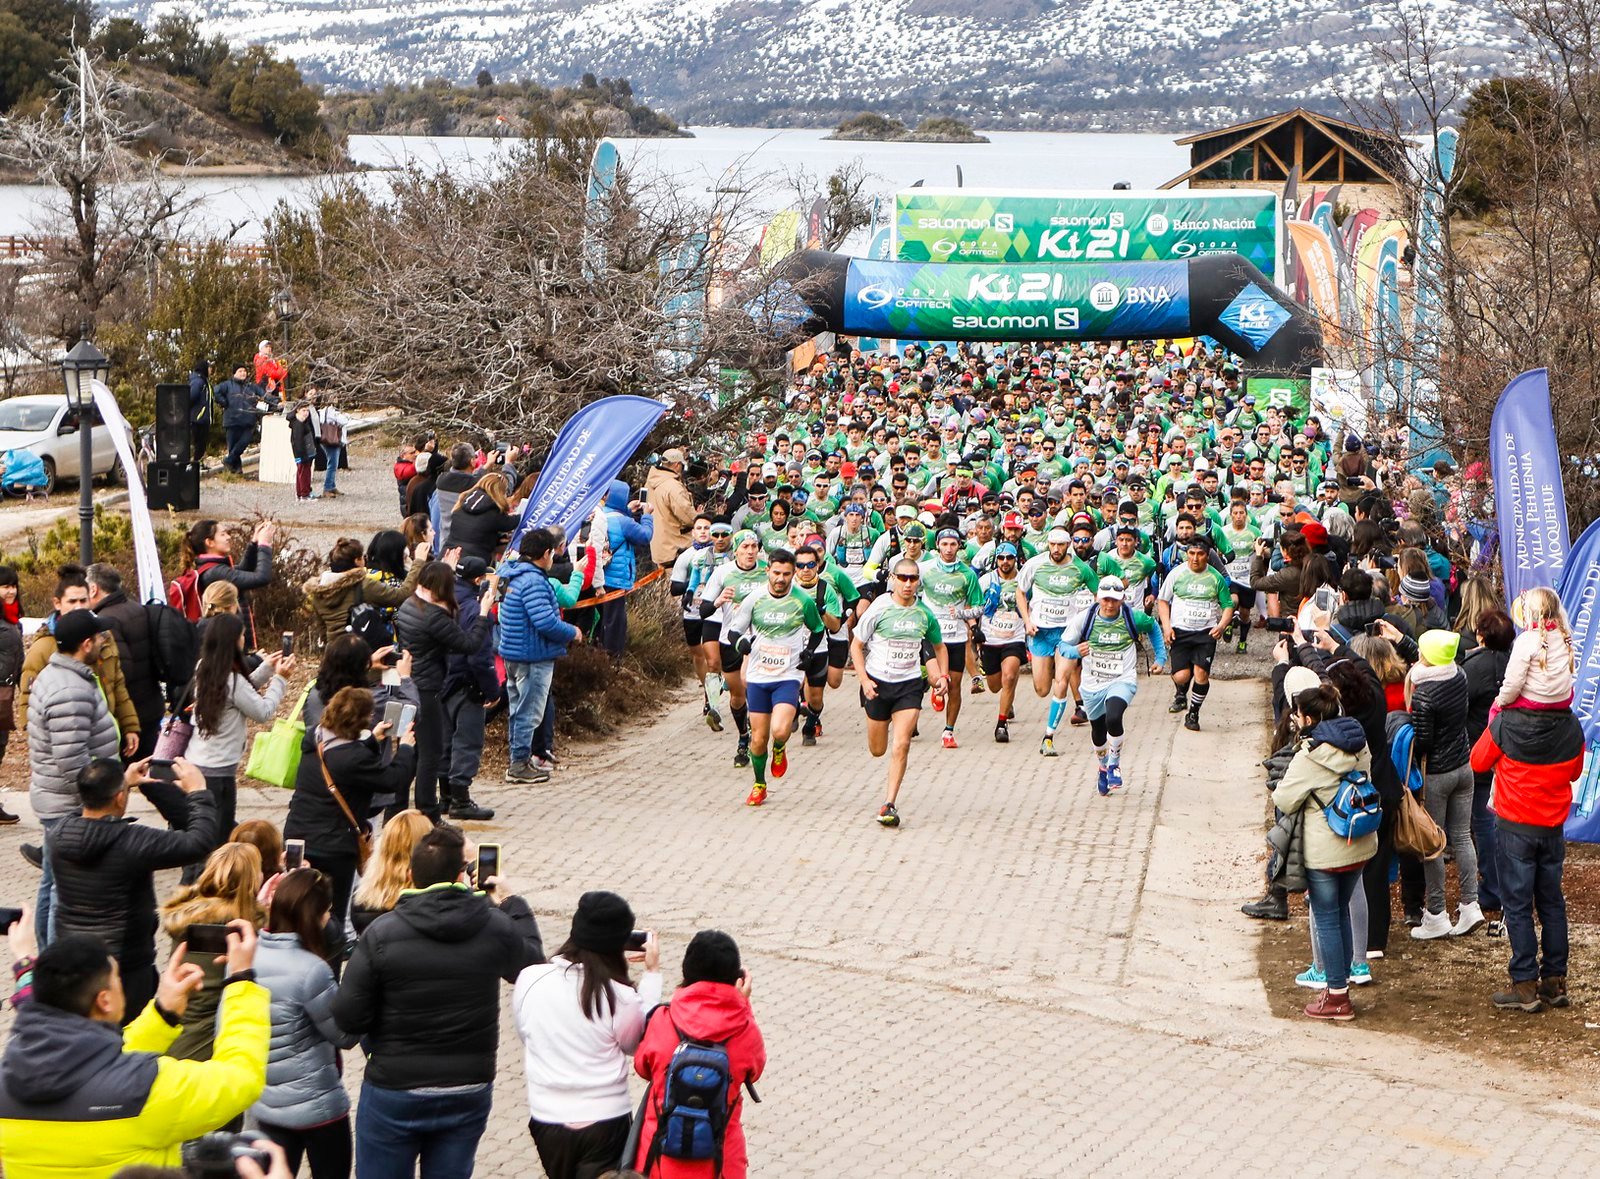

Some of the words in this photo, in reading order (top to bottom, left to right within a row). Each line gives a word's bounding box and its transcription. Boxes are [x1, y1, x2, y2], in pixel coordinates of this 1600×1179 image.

[1173, 219, 1209, 230] Banco
[1212, 217, 1256, 230] Nación
[897, 288, 949, 297] COPA
[1126, 287, 1171, 304] BNA
[895, 300, 950, 309] OPTITECH
[952, 315, 1048, 329] salomon
[1505, 432, 1515, 448] DE
[521, 447, 581, 535] MUNICIPALIDAD
[577, 428, 592, 447] DE
[556, 452, 597, 508] PEHUENIA
[1520, 450, 1537, 523] PEHUENIA
[559, 483, 592, 525] QUEHUE
[1508, 451, 1531, 569] MUNICIPALIDAD
[1542, 484, 1564, 568] MOQUEHUE
[1526, 527, 1546, 569] VILLA
[1188, 610, 1207, 618] 1022
[994, 620, 1013, 629] 2073
[761, 656, 785, 666] 2005
[1095, 661, 1118, 670] 5017
[1577, 674, 1600, 720] VILLA
